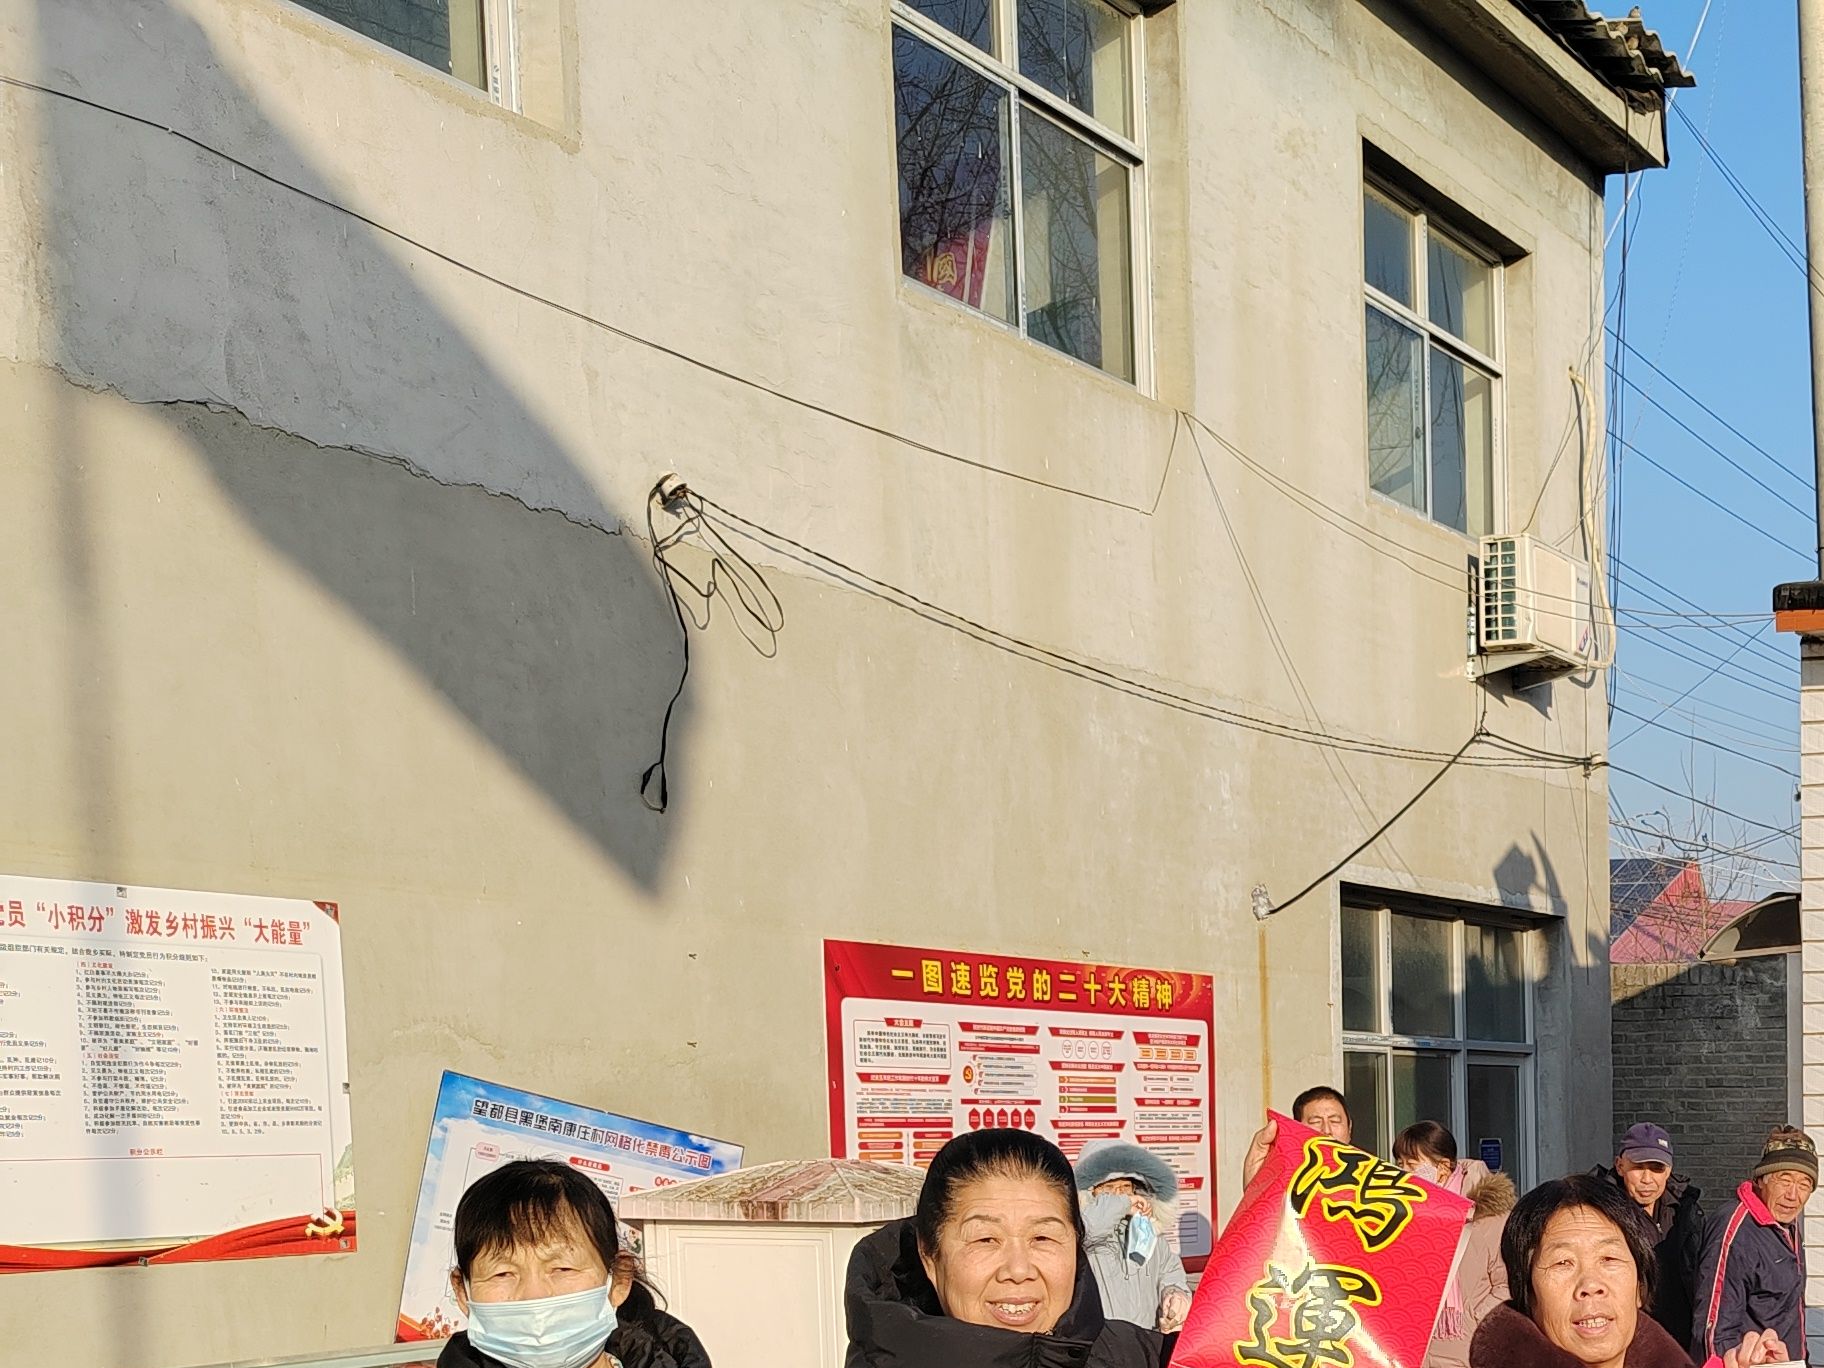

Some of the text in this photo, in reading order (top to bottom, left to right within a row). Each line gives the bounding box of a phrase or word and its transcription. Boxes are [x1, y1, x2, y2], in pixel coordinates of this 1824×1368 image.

[891, 959, 1174, 1011] 一图速览党的二十大精神
[472, 1099, 713, 1170] 望都县黑堡南康庄村网格化禁毒公示图
